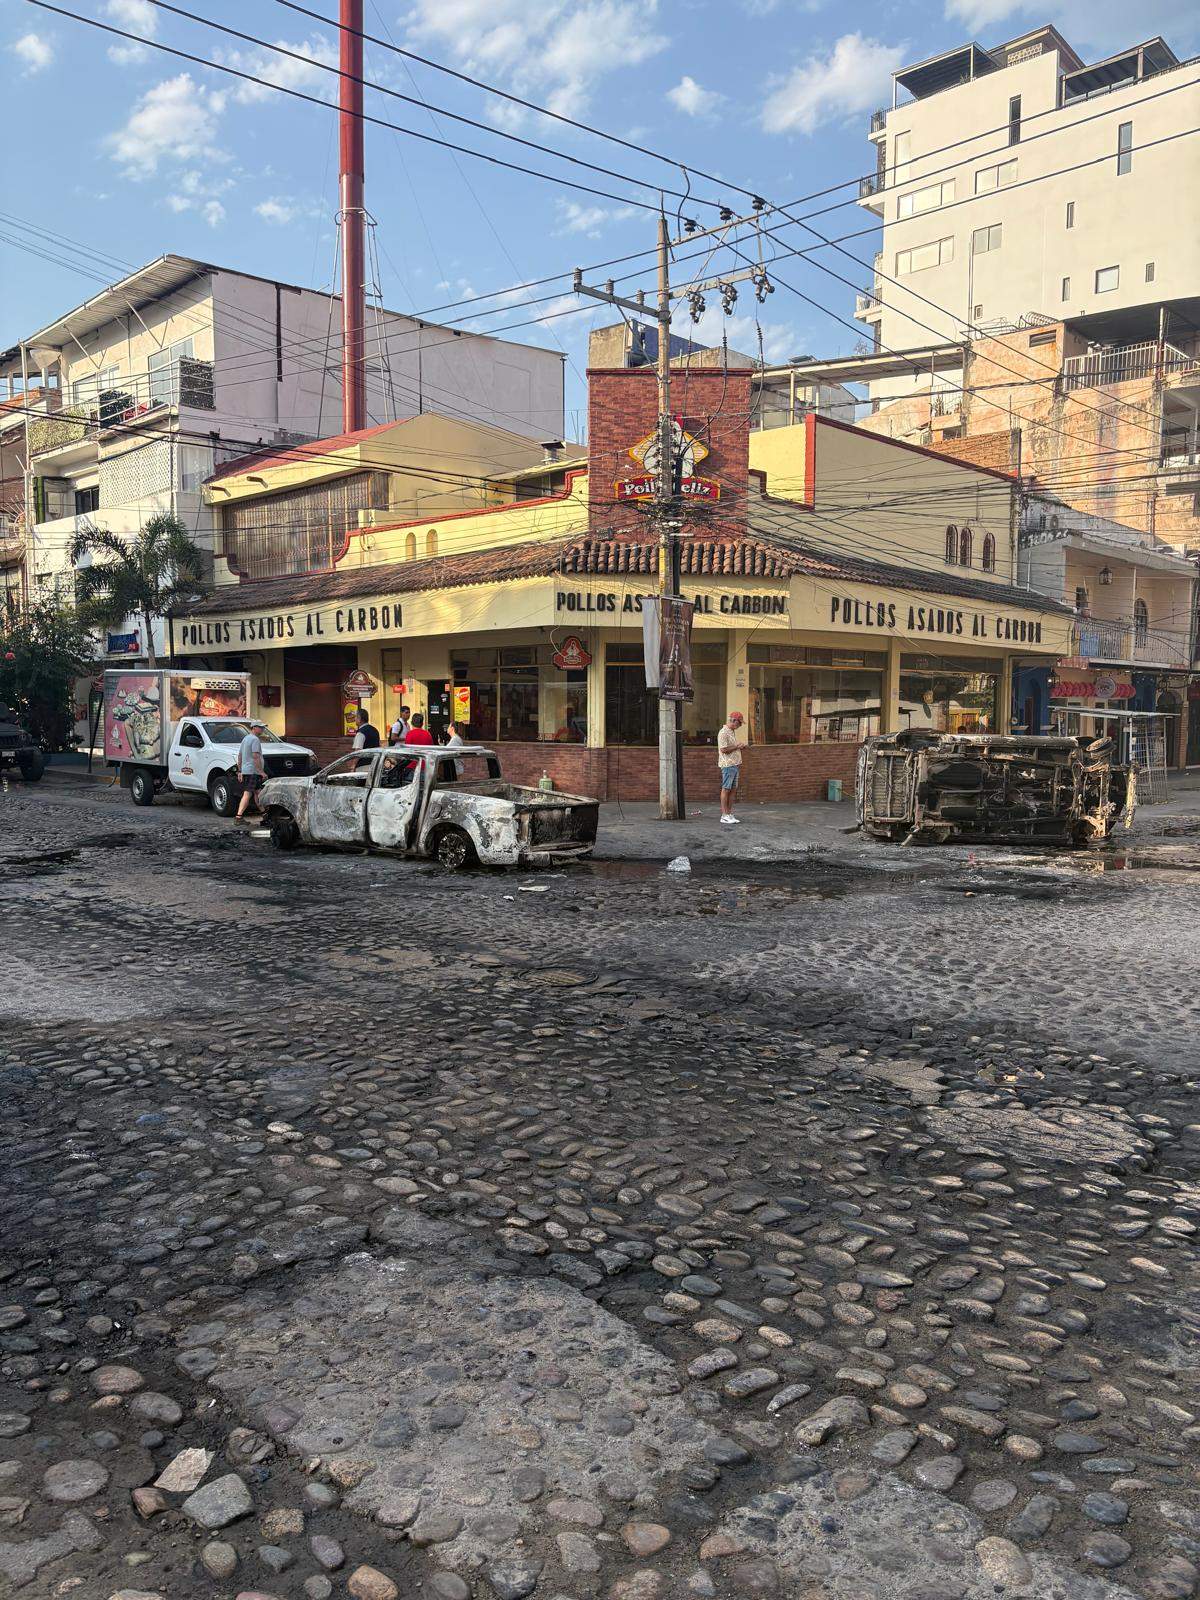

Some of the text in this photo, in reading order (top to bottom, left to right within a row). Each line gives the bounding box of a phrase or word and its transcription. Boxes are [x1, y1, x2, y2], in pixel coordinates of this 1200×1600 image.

[182, 603, 403, 646] POLLOS ASADOS AL CARBON
[556, 592, 616, 612] POLLOS
[694, 595, 713, 614] AL
[720, 595, 785, 614] CARBON
[831, 596, 1042, 643] POLLOS ASADOS AL CARBON
